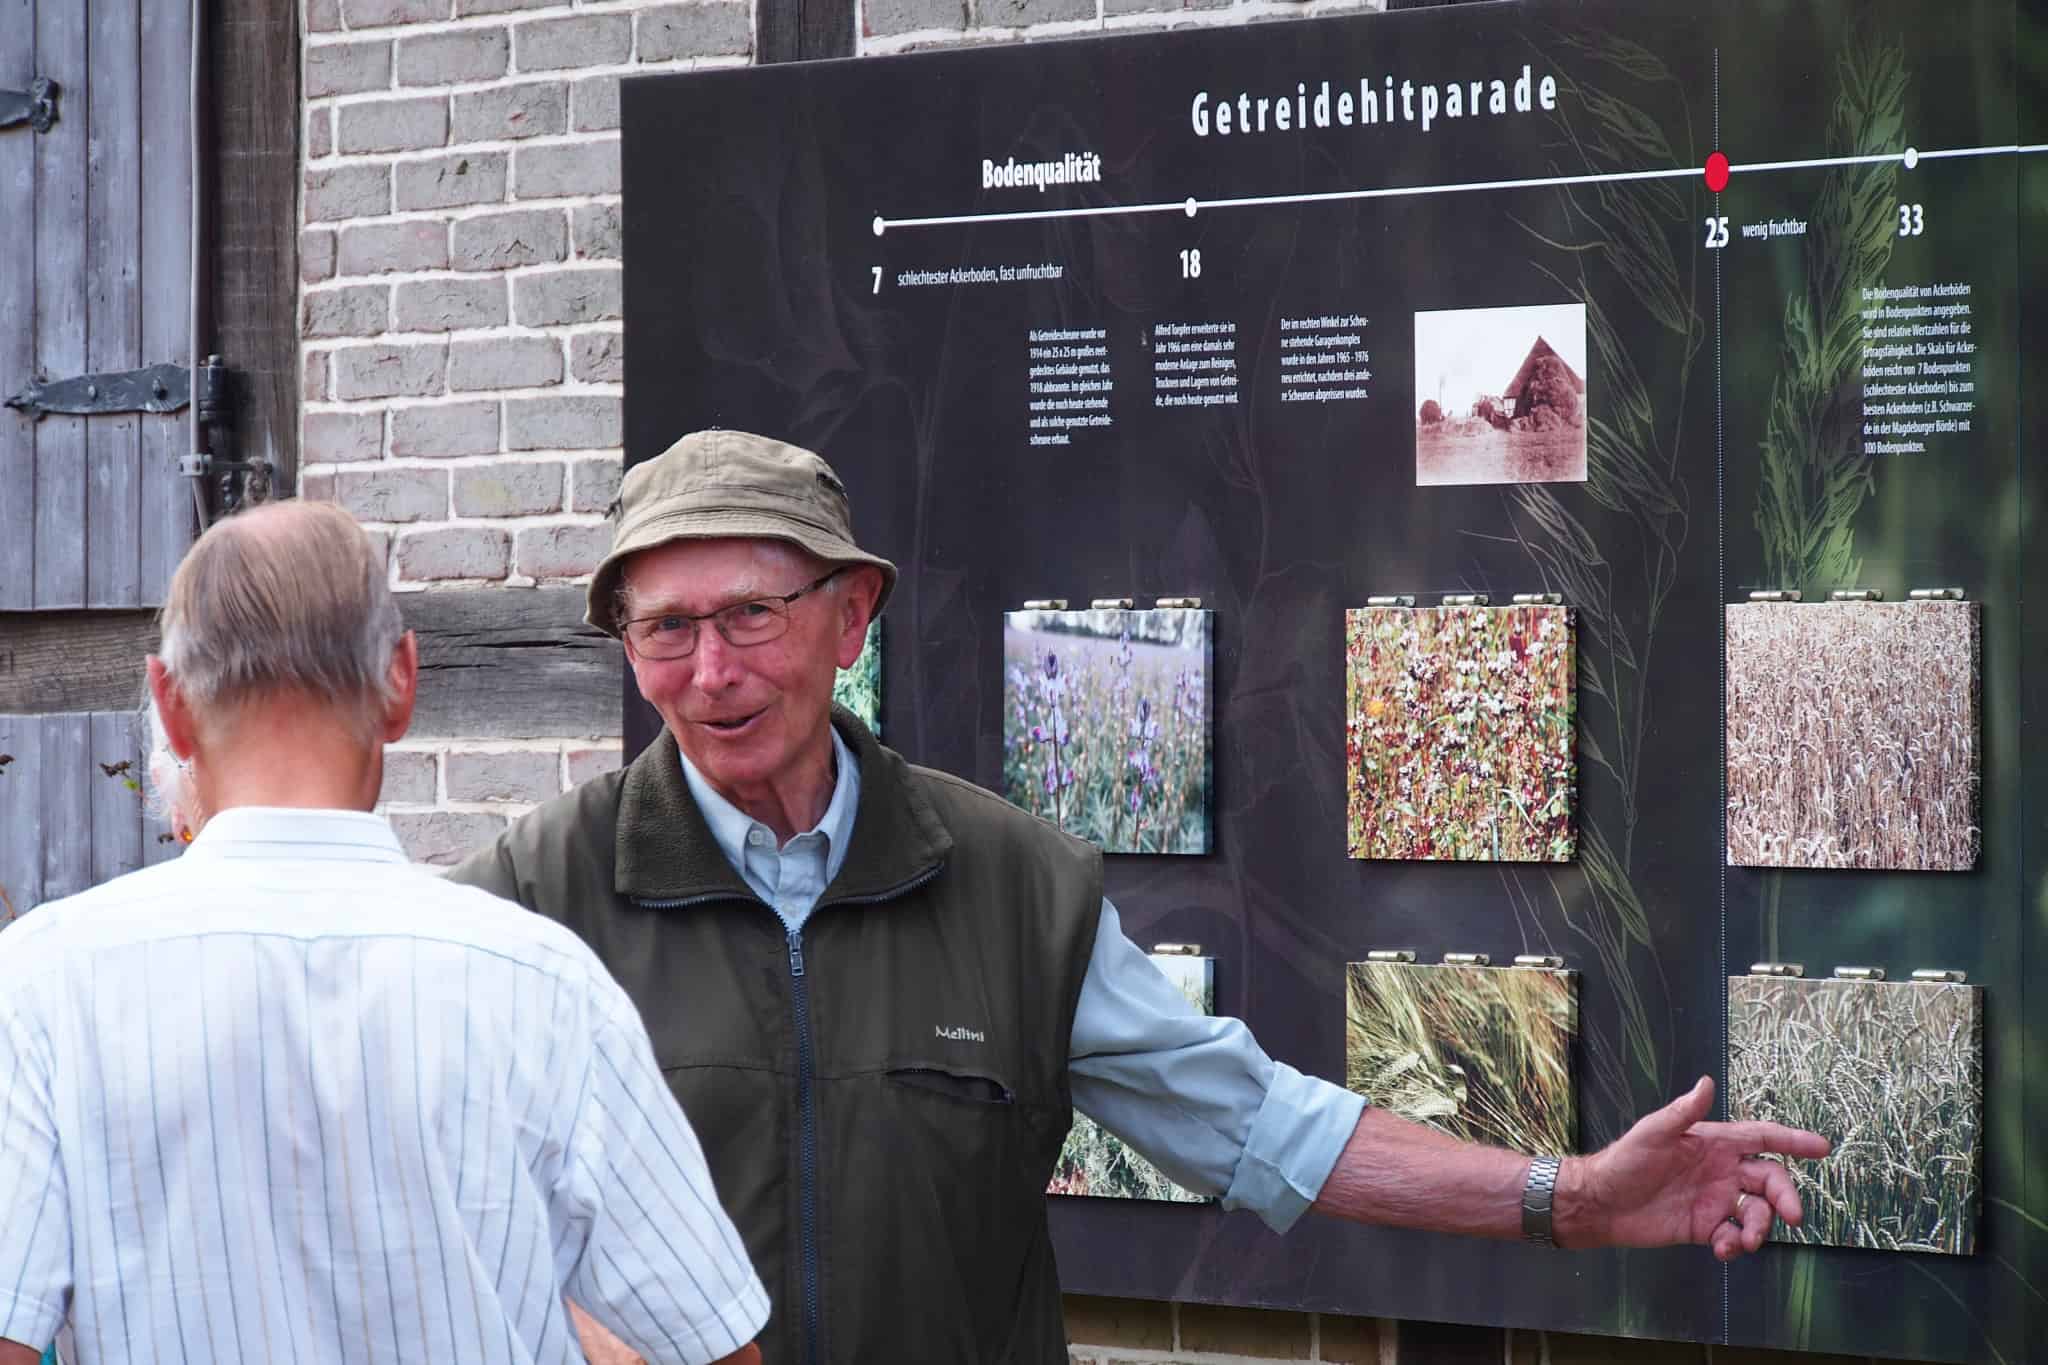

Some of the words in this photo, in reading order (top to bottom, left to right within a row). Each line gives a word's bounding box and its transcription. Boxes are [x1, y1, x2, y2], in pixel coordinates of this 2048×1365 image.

[1192, 64, 1557, 136] Getreidehitparade
[982, 152, 1101, 192] Bodenqualität
[1742, 219, 1768, 240] wenig
[1769, 217, 1808, 236] fruchtbar
[1899, 204, 1924, 237] 33
[1705, 217, 1729, 248] 25
[1179, 248, 1202, 279] 18
[871, 266, 883, 294] 7
[897, 269, 949, 286] schlechtester
[949, 266, 999, 284] Ackerboden,
[999, 265, 1016, 281] fast
[1016, 263, 1064, 280] unfruchtbar
[1862, 287, 1873, 300] Die
[1873, 285, 1919, 301] Bodenqualität
[1919, 287, 1932, 297] von
[1932, 282, 1971, 296] Ackerböden
[1862, 308, 1878, 320] wird
[1878, 308, 1885, 320] in
[1885, 304, 1932, 320] Bodenpunkten
[1933, 301, 1972, 318] angegeben.
[1155, 324, 1171, 336] Alfred
[1191, 324, 1218, 335] erweiterte
[1219, 321, 1228, 333] sie
[1228, 321, 1236, 333] im
[1281, 318, 1291, 330] Der
[1291, 318, 1299, 330] im
[1299, 316, 1320, 329] rechten
[1320, 315, 1340, 328] Winkel
[1340, 318, 1349, 328] zur
[1349, 314, 1369, 327] Scheu-
[1862, 326, 1873, 339] Sie
[1873, 325, 1887, 338] sind
[1888, 324, 1912, 337] relative
[1912, 323, 1949, 336] Wertzahlen
[1949, 322, 1959, 334] für
[1960, 321, 1971, 334] die
[1155, 342, 1167, 353] Jahr
[1167, 341, 1181, 353] 1966
[1181, 343, 1191, 353] um
[1190, 341, 1203, 352] eine
[1202, 338, 1222, 352] damals
[1223, 338, 1235, 351] sehr
[1281, 339, 1289, 348] ne
[1288, 335, 1314, 347] stehende
[1314, 332, 1361, 349] Garagenkomplex
[1281, 353, 1299, 366] wurde
[1299, 352, 1306, 365] in
[1306, 352, 1317, 365] den
[1317, 351, 1336, 364] Jahren
[1336, 351, 1350, 363] 1965
[1863, 343, 1915, 360] Ertragsfähigkeit.
[1916, 343, 1926, 355] Die
[1927, 342, 1944, 355] Skala
[1945, 341, 1956, 354] für
[1956, 341, 1976, 354] Acker-
[1155, 359, 1180, 371] moderne
[1179, 358, 1198, 373] Anlage
[1199, 360, 1211, 369] zum
[1211, 357, 1237, 372] Reinigen,
[1863, 364, 1883, 377] böden
[1884, 363, 1902, 376] reicht
[1903, 367, 1915, 376] von
[1918, 362, 1923, 375] 7
[1923, 361, 1971, 376] Bodenpunkten
[1155, 376, 1179, 389] Trocknen
[1179, 375, 1190, 388] und
[1190, 375, 1210, 390] Lagern
[1209, 377, 1220, 387] von
[1220, 374, 1240, 386] Getrei-
[1281, 374, 1292, 384] neu
[1292, 370, 1318, 384] errichtet,
[1317, 369, 1343, 382] nachdem
[1343, 369, 1355, 381] drei
[1355, 368, 1372, 380] ande-
[1281, 392, 1288, 401] re
[1287, 389, 1315, 401] Scheunen
[1315, 388, 1345, 403] abgerissen
[1345, 386, 1368, 399] wurden.
[1863, 383, 1907, 398] (schlechtester
[1907, 380, 1947, 395] Ackerboden)
[1948, 380, 1958, 393] bis
[1959, 382, 1974, 392] zum
[1155, 394, 1165, 408] de,
[1164, 393, 1173, 406] die
[1173, 393, 1186, 406] noch
[1186, 393, 1203, 405] heute
[1203, 394, 1225, 407] genutzt
[1224, 391, 1240, 404] wird.
[1863, 403, 1885, 416] besten
[1886, 400, 1923, 415] Ackerboden
[1939, 400, 1976, 413] Schwarzer-
[1863, 422, 1873, 435] de
[1873, 422, 1880, 434] in
[1880, 422, 1892, 434] der
[1892, 420, 1936, 437] Magdeburger
[1936, 419, 1958, 433] Börde)
[1958, 419, 1971, 431] mit
[1864, 441, 1876, 454] 100
[1877, 440, 1926, 456] Bodenpunkten.
[935, 1024, 984, 1042] Mellini
